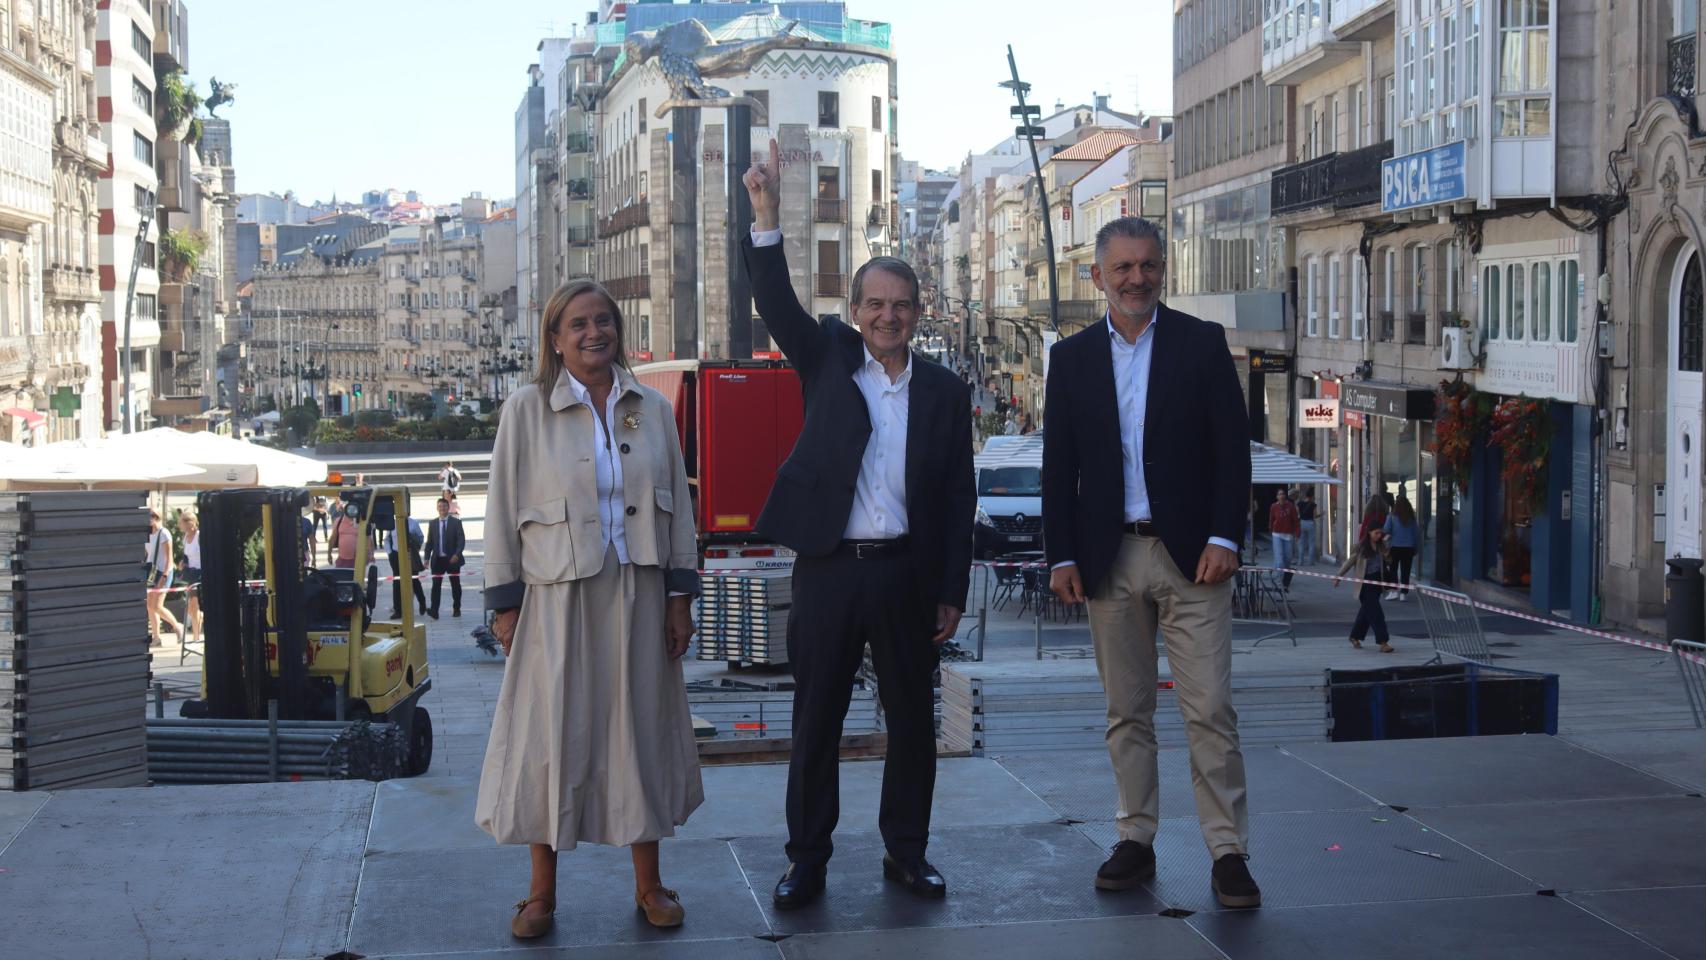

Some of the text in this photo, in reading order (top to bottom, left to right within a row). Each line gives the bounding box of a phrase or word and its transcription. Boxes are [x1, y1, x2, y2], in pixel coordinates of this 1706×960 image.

[1384, 156, 1430, 208] PSICA
[1488, 368, 1505, 379] OVER
[1509, 369, 1520, 381] THE
[1345, 388, 1352, 406] AS
[1353, 389, 1377, 409] Computer
